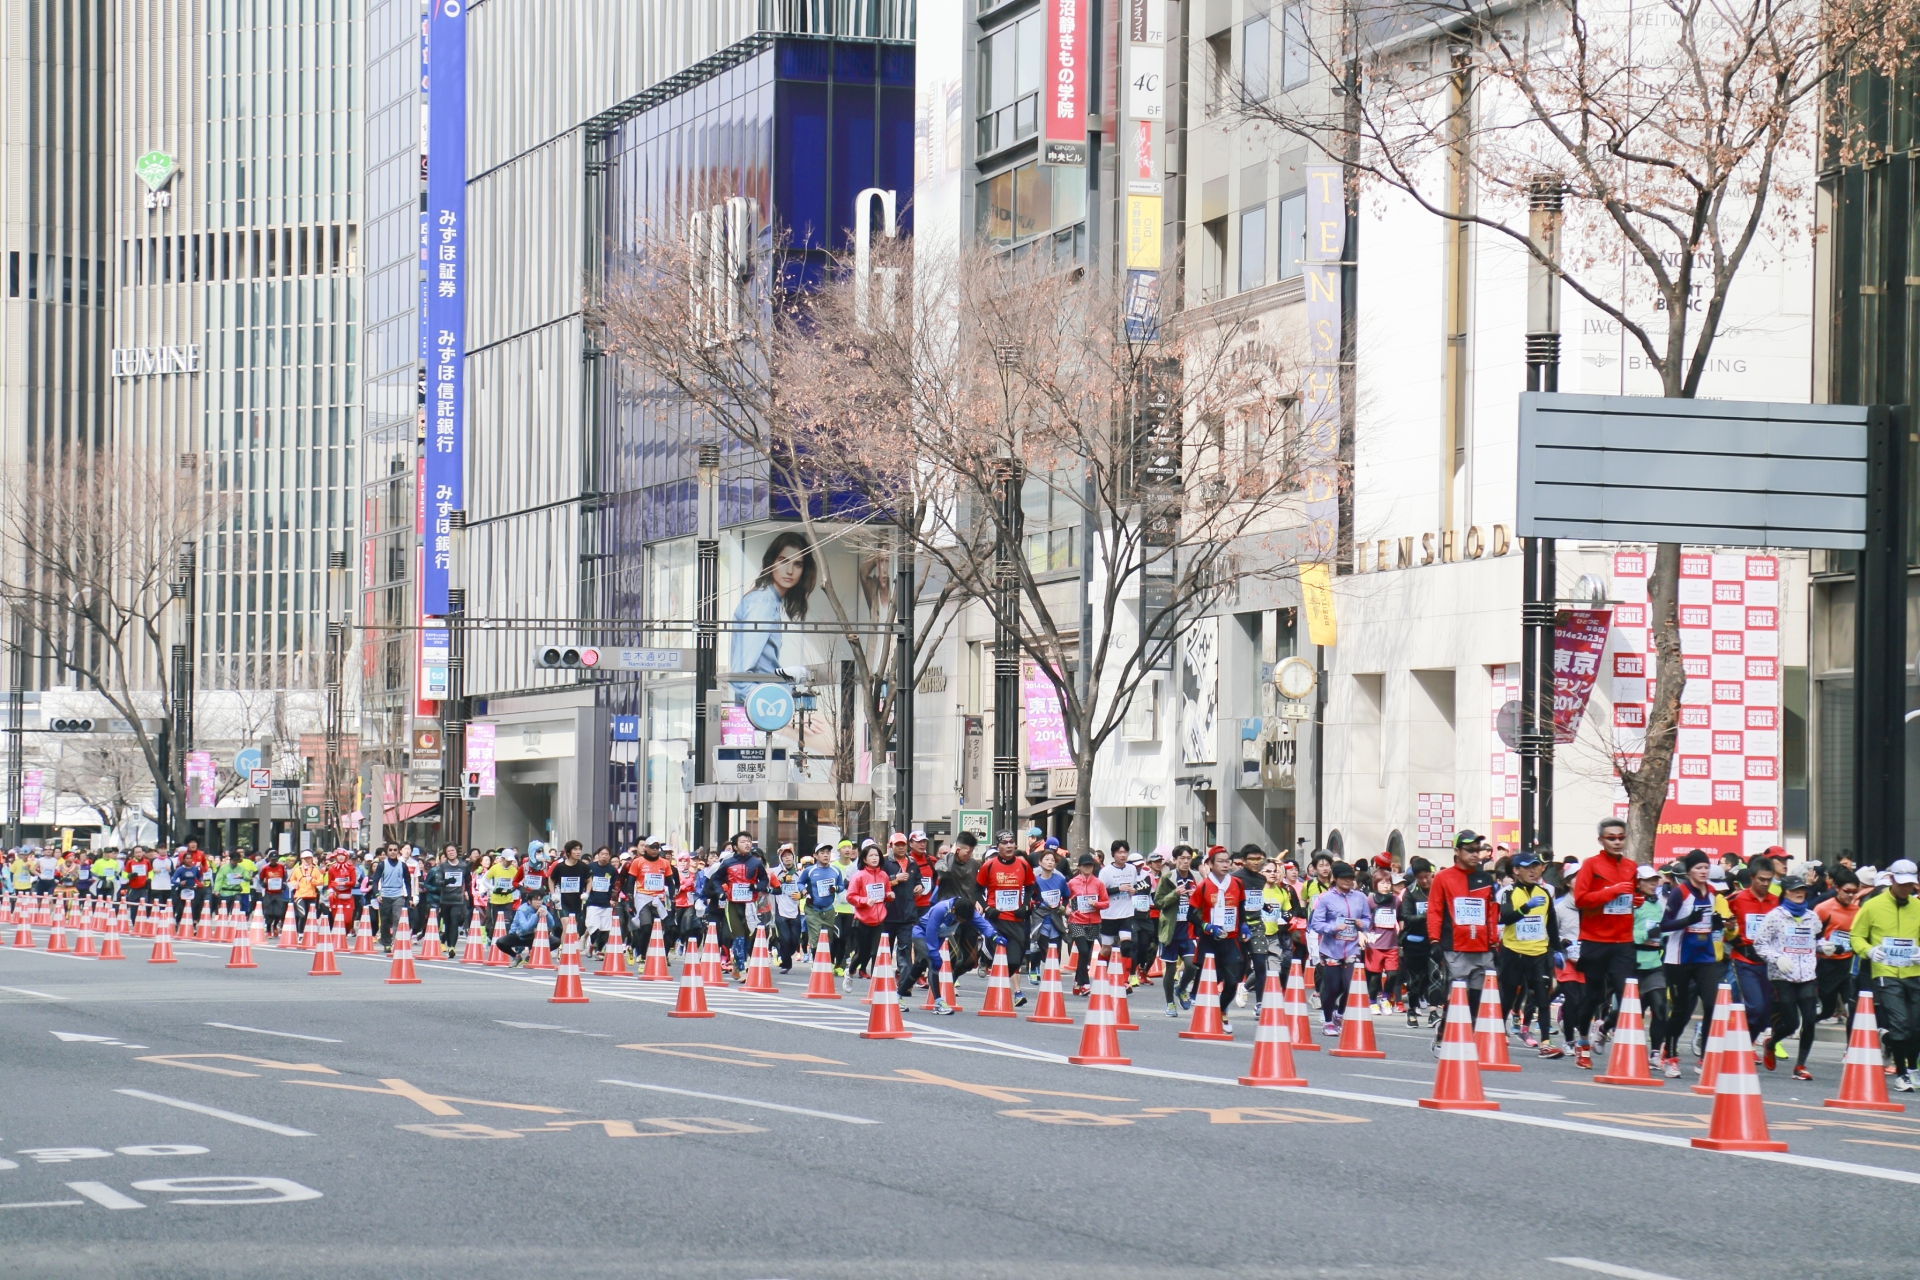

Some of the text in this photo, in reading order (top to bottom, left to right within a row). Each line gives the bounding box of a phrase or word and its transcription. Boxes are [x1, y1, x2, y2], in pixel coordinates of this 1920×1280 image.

[1149, 31, 1162, 40] 7F
[1147, 106, 1161, 115] 6F
[1048, 152, 1082, 162] 中央ビル
[438, 209, 457, 298] みずほ証券
[1583, 319, 1620, 336] IWC
[112, 344, 199, 377] LUMINE
[1308, 172, 1338, 551] TENSHODO
[1629, 357, 1747, 373] BRTING
[436, 330, 456, 453] みずほ信託銀行
[435, 485, 453, 570] みずほ銀行
[1355, 523, 1525, 574] TENSHOD
[1618, 563, 1643, 573] SALE
[1683, 564, 1708, 575] SALE
[1748, 566, 1774, 576] SALE
[1716, 590, 1741, 601] SALE
[1319, 581, 1331, 627] BREITLING
[1617, 613, 1643, 623] SALE
[1683, 614, 1708, 625] SALE
[1748, 616, 1774, 626] SALE
[1715, 640, 1741, 651] SALE
[622, 652, 678, 662] 並木通り口
[1554, 649, 1598, 675] 東京
[1617, 663, 1642, 674] SALE
[1683, 665, 1708, 675] SALE
[1748, 666, 1773, 677] SALE
[1715, 690, 1740, 700] SALE
[1028, 697, 1062, 715] 東京
[1617, 713, 1642, 723] SALE
[1682, 715, 1708, 725] SALE
[1748, 716, 1773, 726] SALE
[619, 722, 634, 734] GAP
[1035, 730, 1064, 742] 2014
[1715, 740, 1740, 751] SALE
[468, 747, 494, 759] 東京
[1266, 740, 1296, 765] PUCCI
[736, 763, 766, 773] 銀座駅
[1682, 765, 1708, 775] SALE
[1748, 766, 1773, 776] SALE
[1715, 790, 1740, 801] SALE
[1748, 816, 1773, 826] SALE
[1695, 818, 1738, 836] SALE
[996, 1107, 1373, 1126] 8-20
[394, 1117, 771, 1139] 8-20
